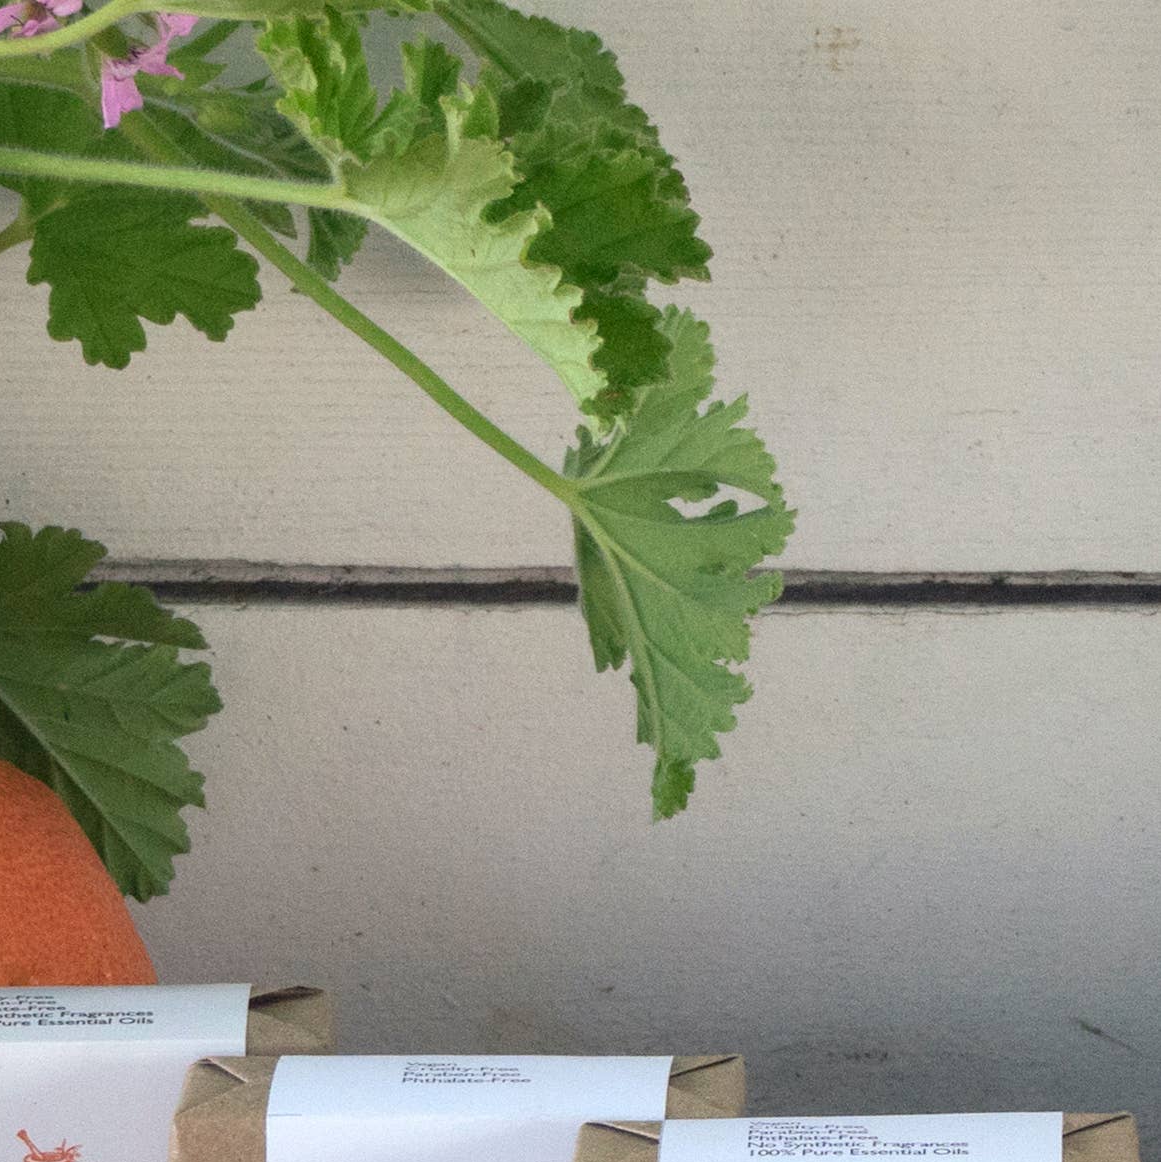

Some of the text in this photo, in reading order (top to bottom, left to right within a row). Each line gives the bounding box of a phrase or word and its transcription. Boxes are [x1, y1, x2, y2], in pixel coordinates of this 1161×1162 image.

[38, 1018, 112, 1026] Essential
[119, 1017, 153, 1025] Oils
[784, 1141, 865, 1149] Synthetic
[802, 1148, 842, 1156] Pure
[850, 1148, 926, 1156] Essential
